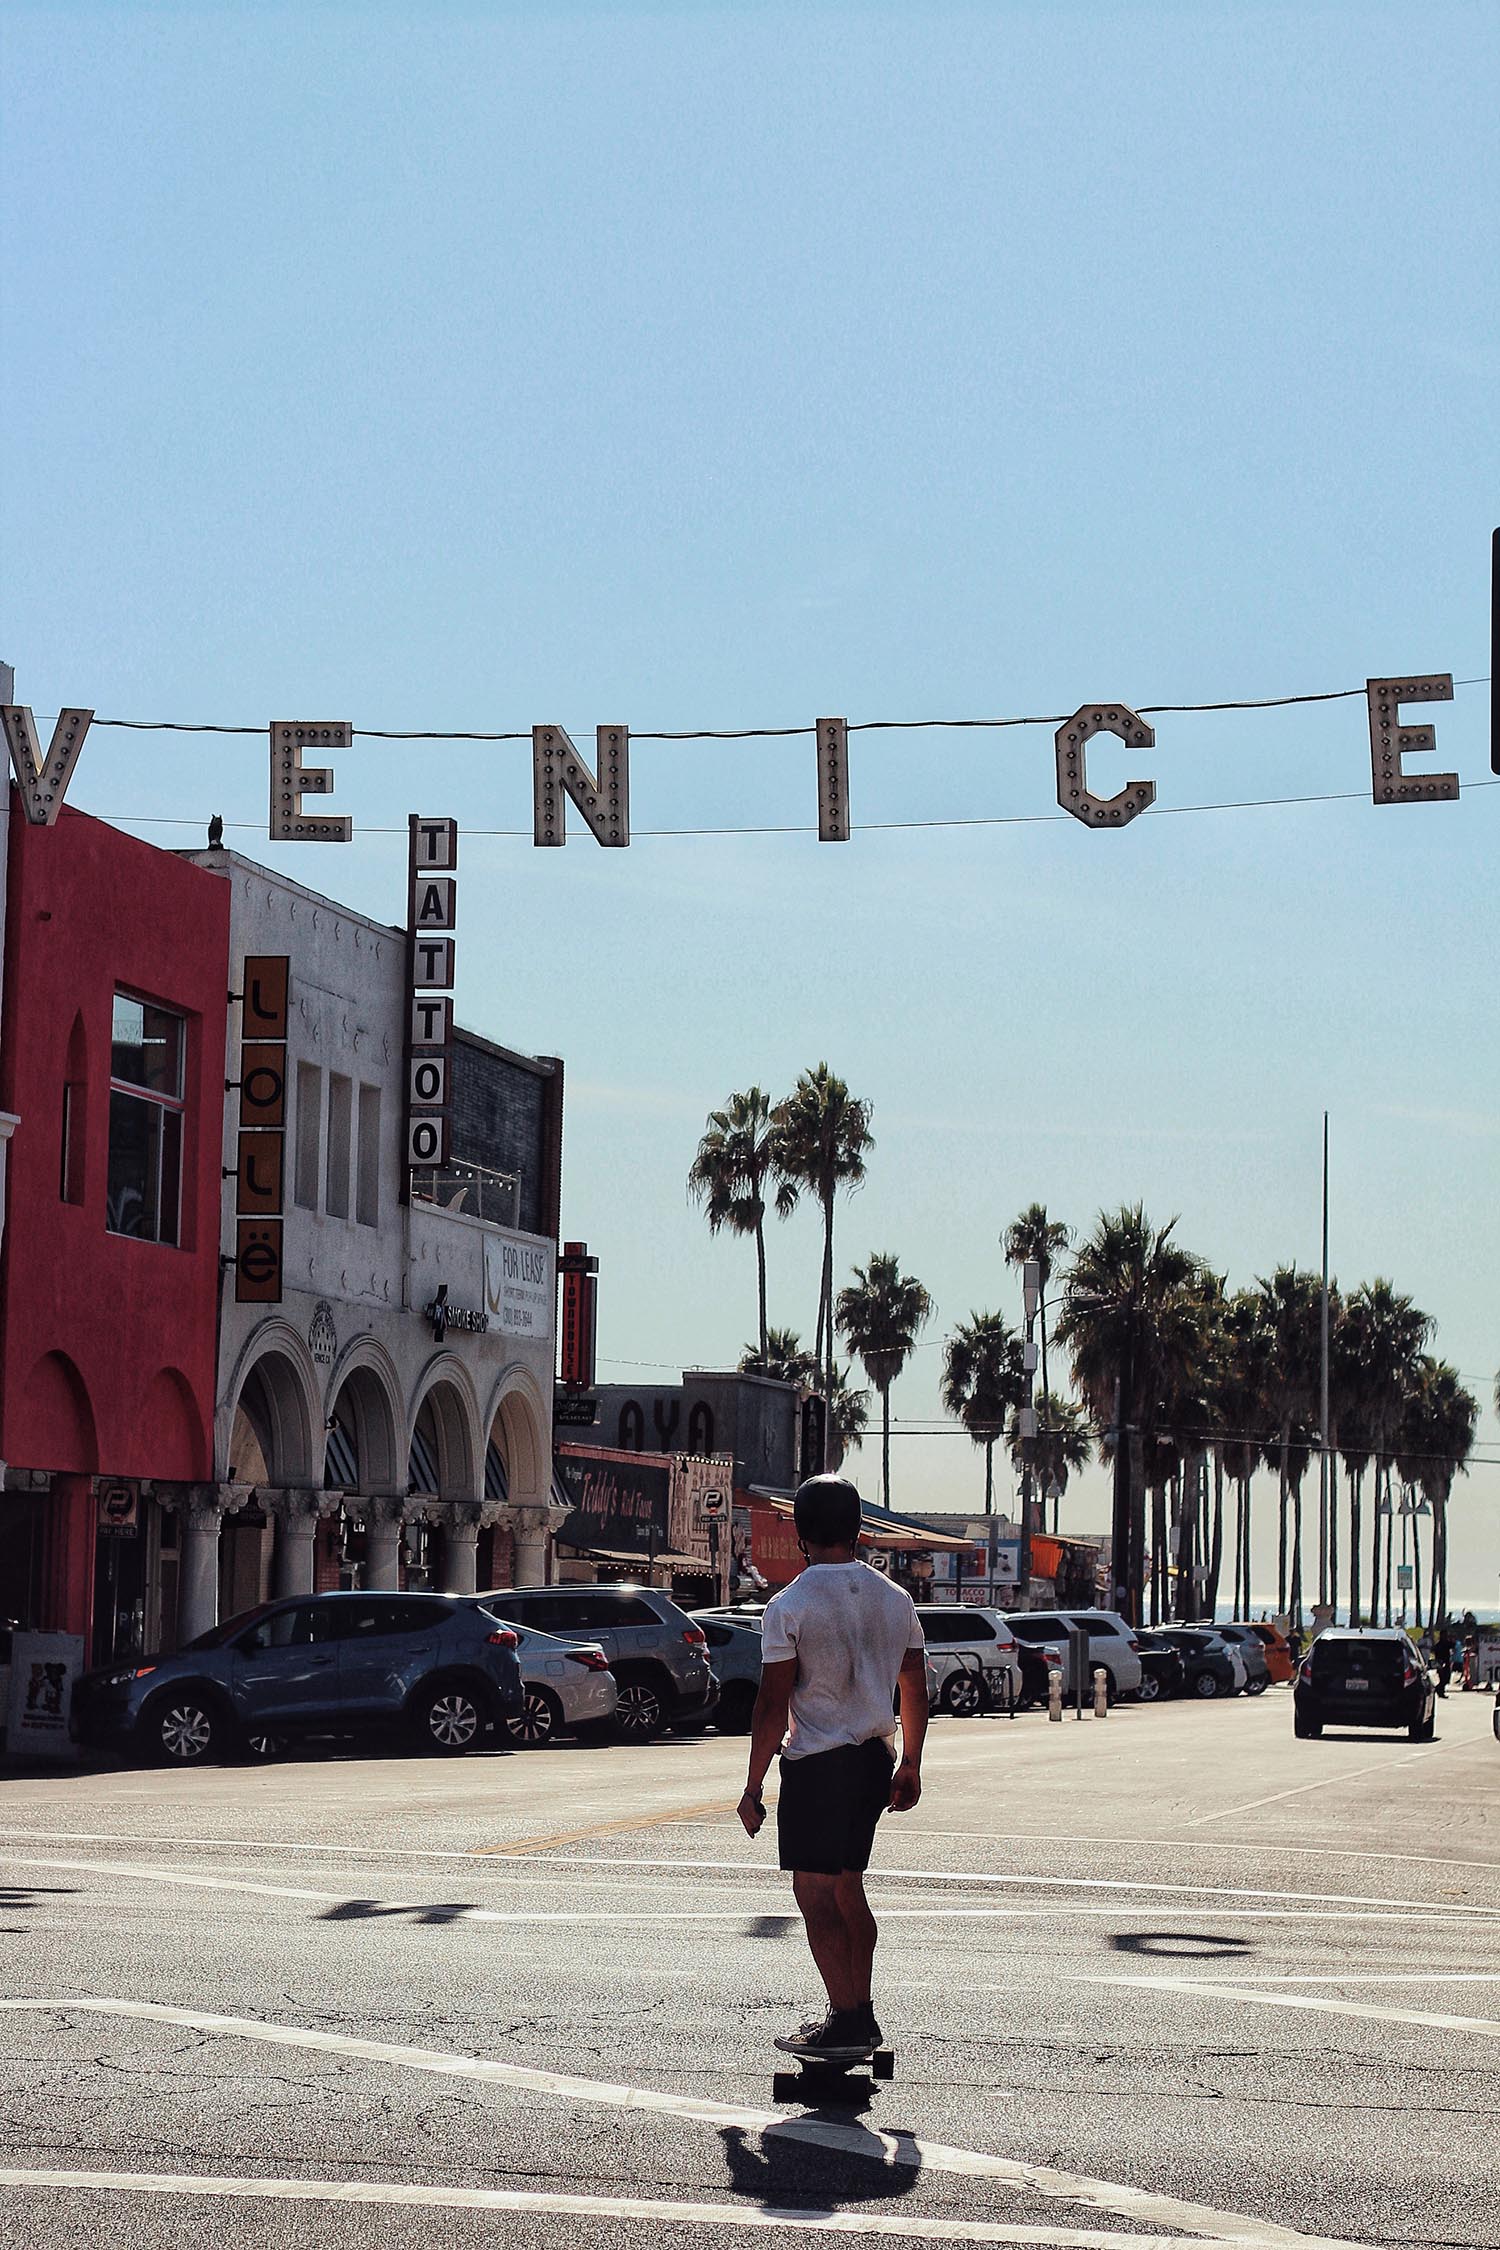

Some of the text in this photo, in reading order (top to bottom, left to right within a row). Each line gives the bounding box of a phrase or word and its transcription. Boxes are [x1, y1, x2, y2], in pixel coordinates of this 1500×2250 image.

[0, 675, 1459, 848] VENICE
[411, 824, 446, 1161] TATTOO
[503, 1246, 545, 1285] FOR LEASE
[447, 1305, 471, 1331] SMOKE
[567, 1274, 577, 1376] TOWNHOUSE
[580, 1471, 618, 1535] Teddy's
[944, 1587, 986, 1598] TOACCO
